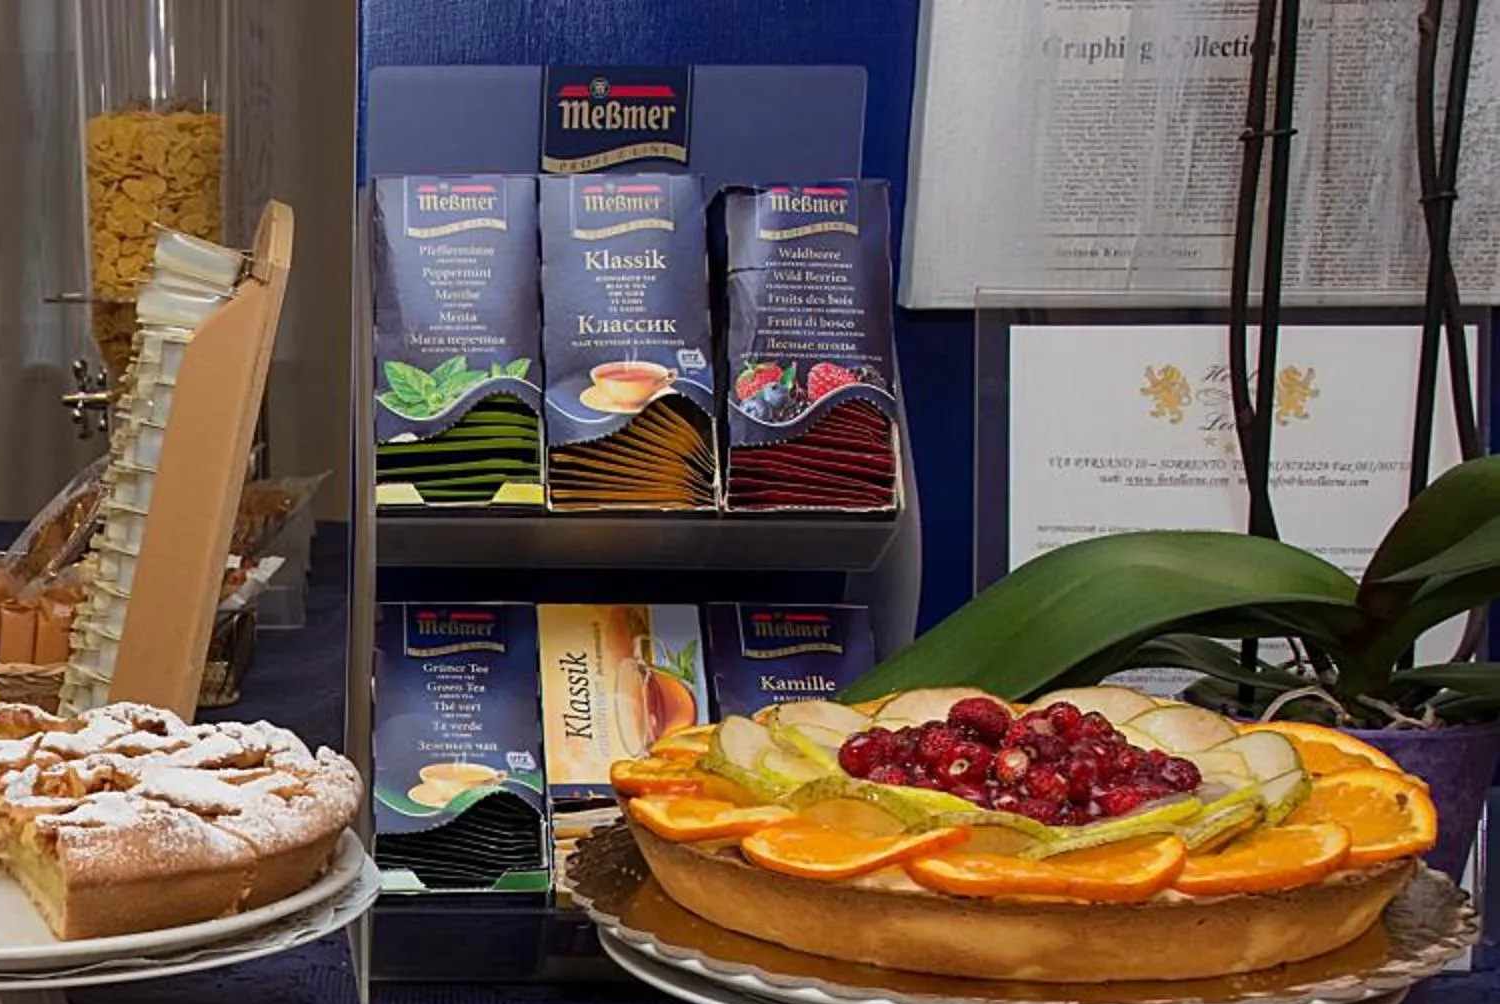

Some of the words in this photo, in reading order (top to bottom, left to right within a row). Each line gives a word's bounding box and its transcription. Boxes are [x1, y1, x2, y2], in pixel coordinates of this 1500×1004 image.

[557, 99, 676, 130] Meßmer
[418, 194, 499, 212] Meßmer
[582, 194, 666, 213] Meßmer
[770, 194, 849, 214] Meßmer
[584, 249, 667, 270] Klassik
[422, 267, 491, 281] Peppermint
[772, 271, 801, 282] Wild
[805, 272, 848, 283] Berries
[767, 293, 803, 304] Fruits
[805, 294, 825, 304] des
[828, 294, 853, 305] bois
[576, 315, 677, 334] Классик
[767, 315, 801, 327] Frutti
[805, 316, 817, 327] di
[820, 316, 855, 328] bosco
[426, 682, 463, 692] Green
[467, 682, 485, 692] Tea
[760, 675, 836, 691] Kamille
[559, 652, 593, 740] Klassik
